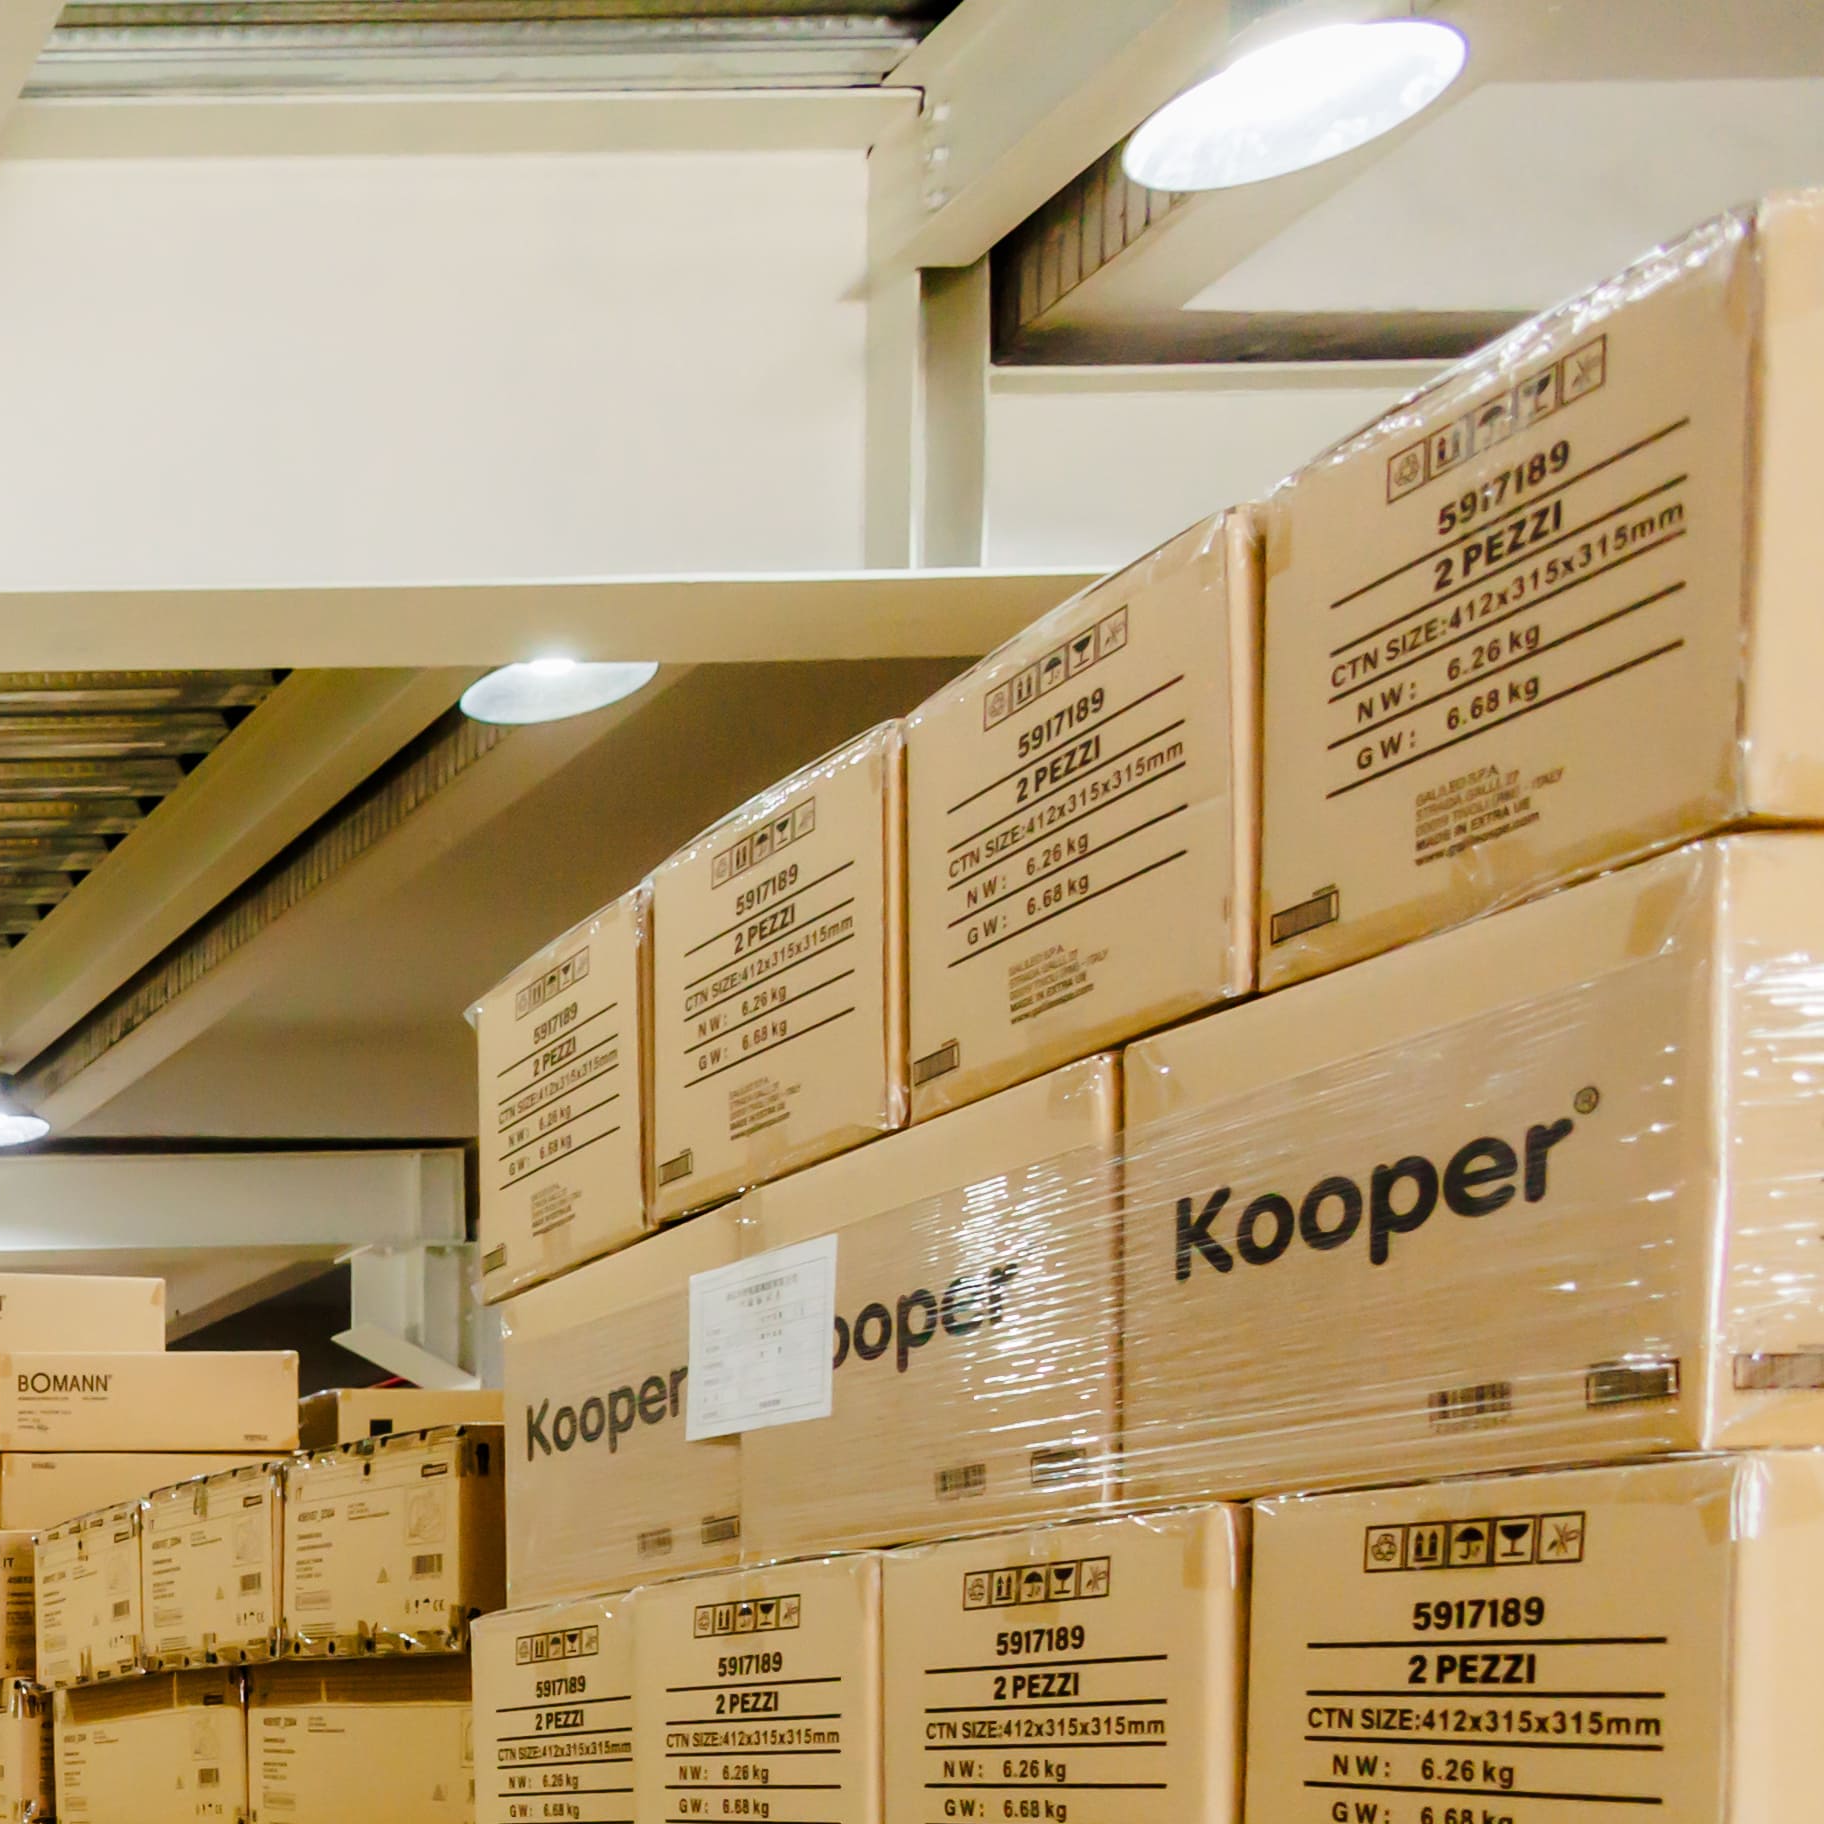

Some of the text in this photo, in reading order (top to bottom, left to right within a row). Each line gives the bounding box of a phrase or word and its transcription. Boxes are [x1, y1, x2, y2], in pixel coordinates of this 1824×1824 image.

[1438, 440, 1571, 536] 5917189
[1434, 500, 1562, 591] 2 PEZZI
[1331, 643, 1378, 688] CTN
[1447, 622, 1541, 682] 6.26 kg
[1447, 673, 1540, 731] 6.68 kg
[1018, 687, 1104, 758] 5917189
[1016, 735, 1101, 804] 2 PEZZI
[736, 864, 799, 916] 5917189
[748, 905, 795, 948] PEZZI
[533, 1002, 577, 1044] 5917189
[543, 1037, 576, 1070] PEZZI
[833, 1264, 1018, 1373] oper
[18, 1373, 111, 1393] BOMANN
[1412, 1596, 1545, 1630] 5917189
[995, 1625, 1085, 1656] 5917189
[718, 1652, 782, 1677] 5917189
[1408, 1653, 1537, 1685] 2 PEZZI
[536, 1676, 586, 1698] 5917189
[728, 1691, 779, 1713] PEZZI
[994, 1672, 1080, 1700] 2 PEZZI
[546, 1710, 584, 1729] PEZZI
[1307, 1707, 1354, 1731] CTN
[1421, 1758, 1514, 1789] 6.26 kg
